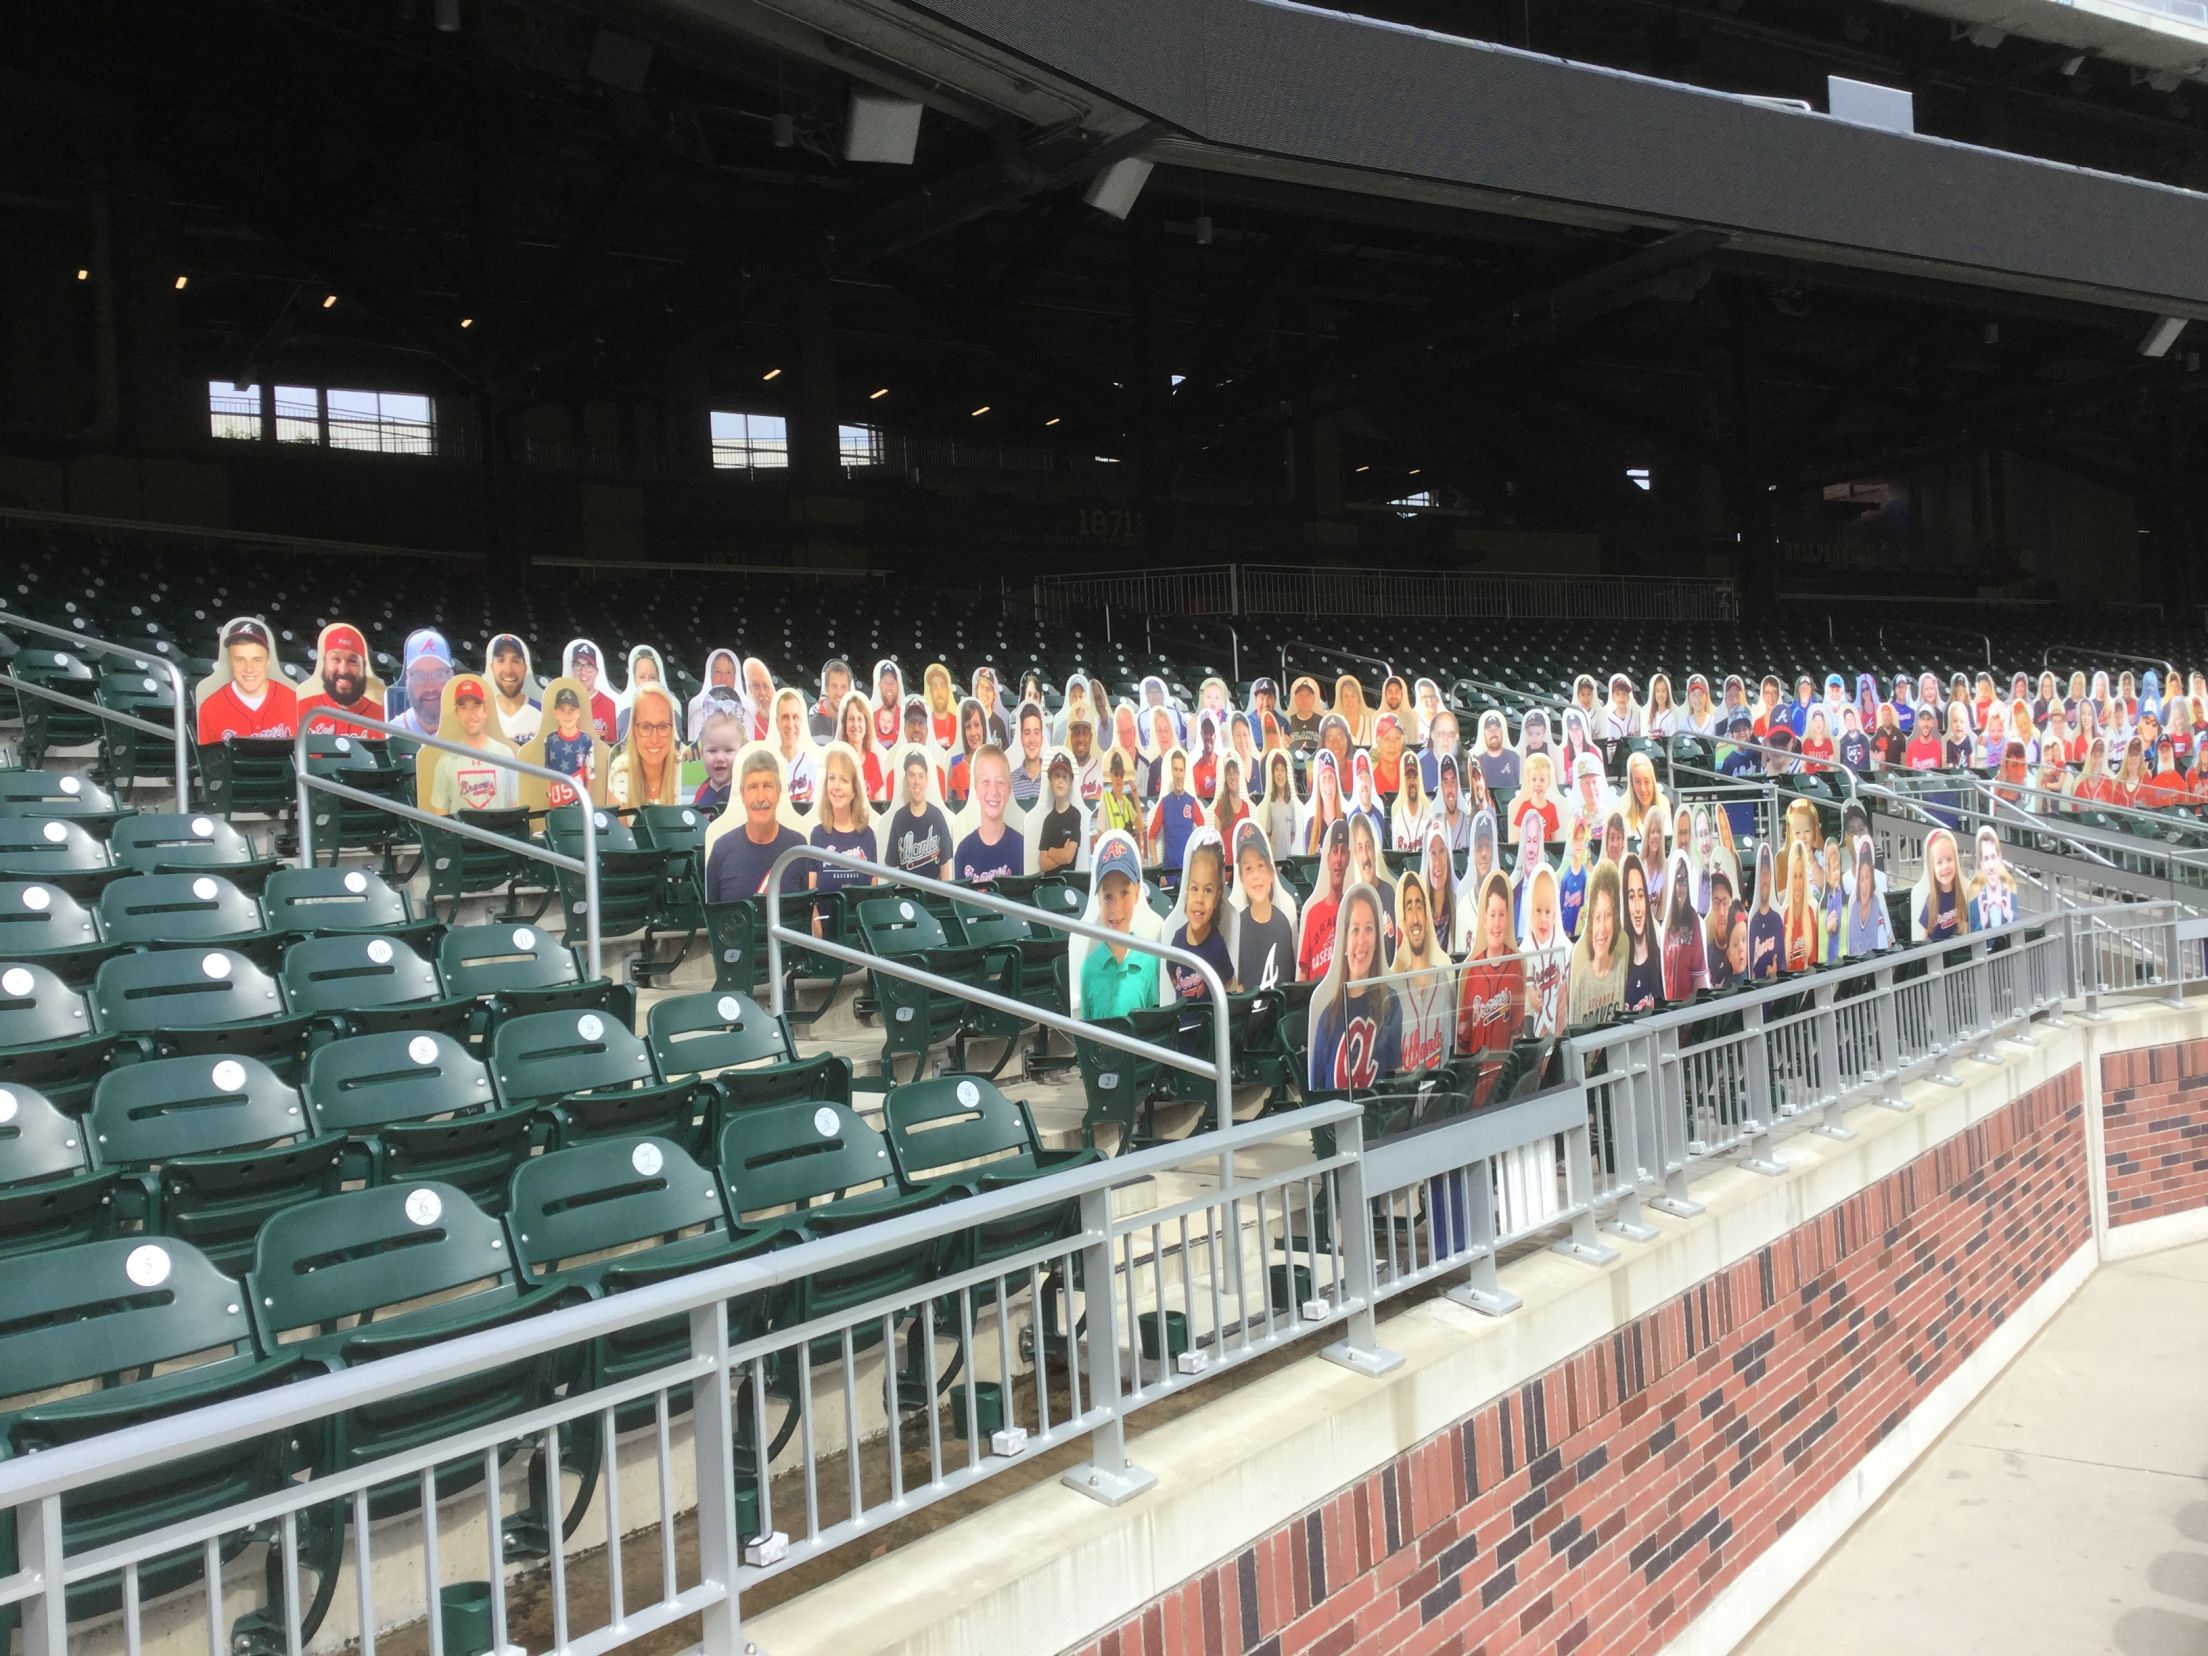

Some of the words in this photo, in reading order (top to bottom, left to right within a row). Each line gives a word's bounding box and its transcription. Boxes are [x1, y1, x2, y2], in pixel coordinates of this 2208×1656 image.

[420, 638, 436, 653] A
[578, 642, 590, 654] A
[1775, 708, 1789, 723] A
[1407, 754, 1414, 764] A
[1501, 762, 1511, 774] A
[1479, 816, 1489, 827] A
[1104, 1075, 1112, 1086] 2
[419, 1199, 429, 1214] 6
